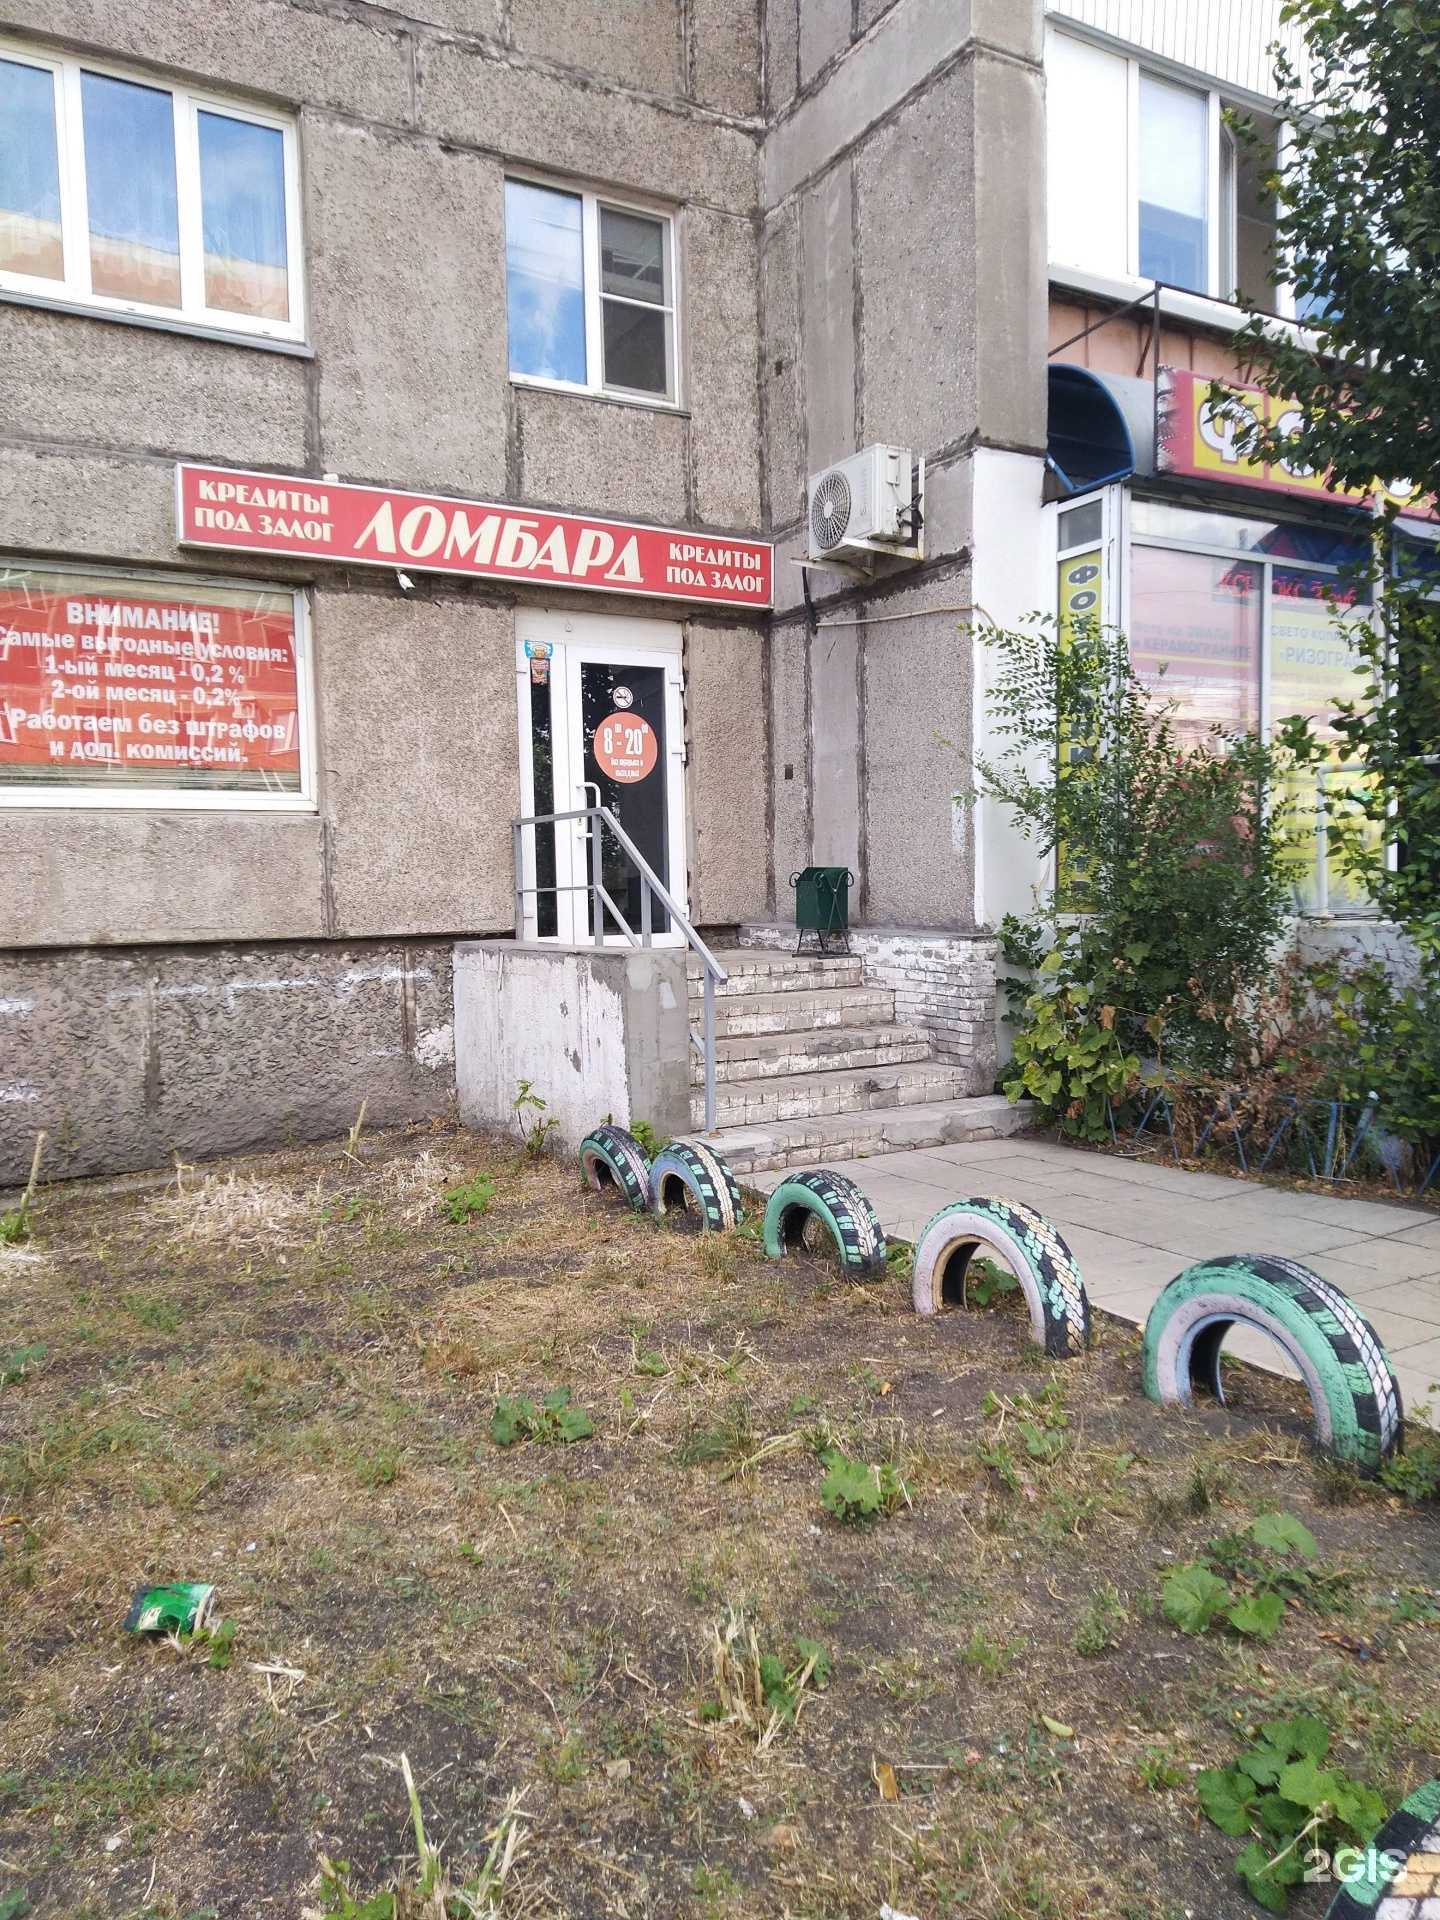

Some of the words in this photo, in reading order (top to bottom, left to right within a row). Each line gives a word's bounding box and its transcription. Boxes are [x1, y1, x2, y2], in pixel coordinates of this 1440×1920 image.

[199, 479, 329, 516] КРЕДИТЫ
[194, 506, 252, 533] ПОД
[257, 515, 334, 543] ЗАЛОГ
[353, 499, 644, 584] ЛОМБАРД
[669, 543, 761, 570] КРЕДИТЫ
[666, 566, 707, 587] ПОД
[711, 571, 764, 593] ЗАЛОГ
[66, 601, 220, 634] ВНИМАНИЕ!
[81, 634, 193, 657] выгодные
[196, 642, 288, 663] условия:
[45, 654, 98, 676] 1-ый
[105, 661, 176, 682] месяц
[192, 662, 224, 686] 0,2
[229, 665, 245, 684] %
[52, 679, 99, 699] 2-ой
[106, 686, 177, 706] месяц
[192, 686, 240, 709] 0,2%
[10, 708, 132, 733] Работаем
[138, 713, 180, 735] без
[186, 719, 286, 743] штрафов
[49, 741, 64, 757] и
[70, 741, 120, 760] доп.
